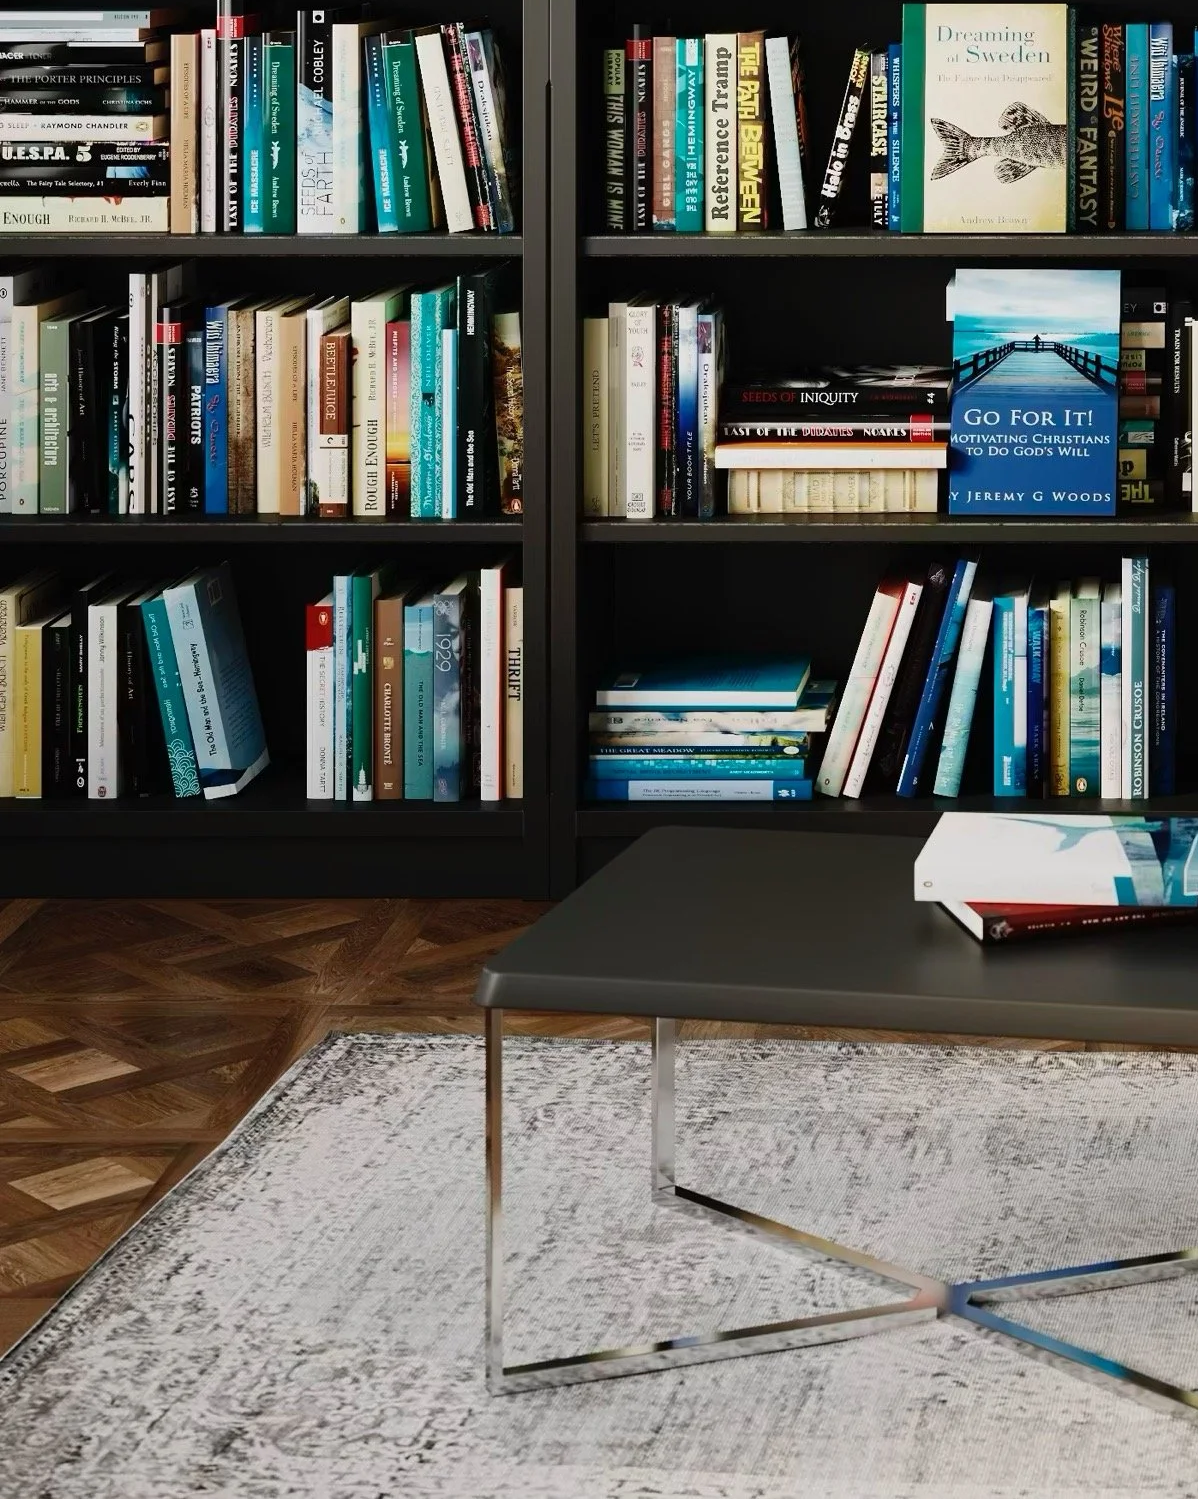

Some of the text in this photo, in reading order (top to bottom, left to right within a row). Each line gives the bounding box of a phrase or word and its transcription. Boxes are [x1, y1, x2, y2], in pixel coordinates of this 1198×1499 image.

[937, 25, 1035, 46] Dreaming
[947, 44, 1052, 63] of Sweden
[80, 76, 141, 84] PRINCIPLES
[271, 61, 280, 134] Dreaming of Sweden
[850, 52, 861, 84] JOHN
[856, 54, 870, 88] EVANS
[687, 70, 696, 155] HEMINGWAY
[712, 47, 732, 220] Reference Tramp
[737, 42, 763, 223] THE PATH BETWEEN
[871, 75, 888, 157] STAIRCASE
[1078, 38, 1098, 226] WEIRD FANTASY
[378, 149, 390, 198] MASSACRE
[606, 95, 624, 230] THIS WOMAN IS MINE
[821, 95, 860, 198] Halo in Brass
[250, 150, 258, 214] ICE MASSACRE
[272, 176, 280, 218] Andrew Brown
[325, 342, 336, 421] BEETLEJUICE
[800, 392, 859, 406] INIQUITY
[724, 427, 906, 437] LAST OF THE PIRATES NOAKES
[466, 430, 475, 506] The Old Man and the Sea
[435, 634, 451, 672] 1929
[1079, 610, 1087, 666] Robinson Crusoe
[508, 647, 521, 702] THRIFT
[1133, 681, 1143, 796] ROBINSON CRUSOE
